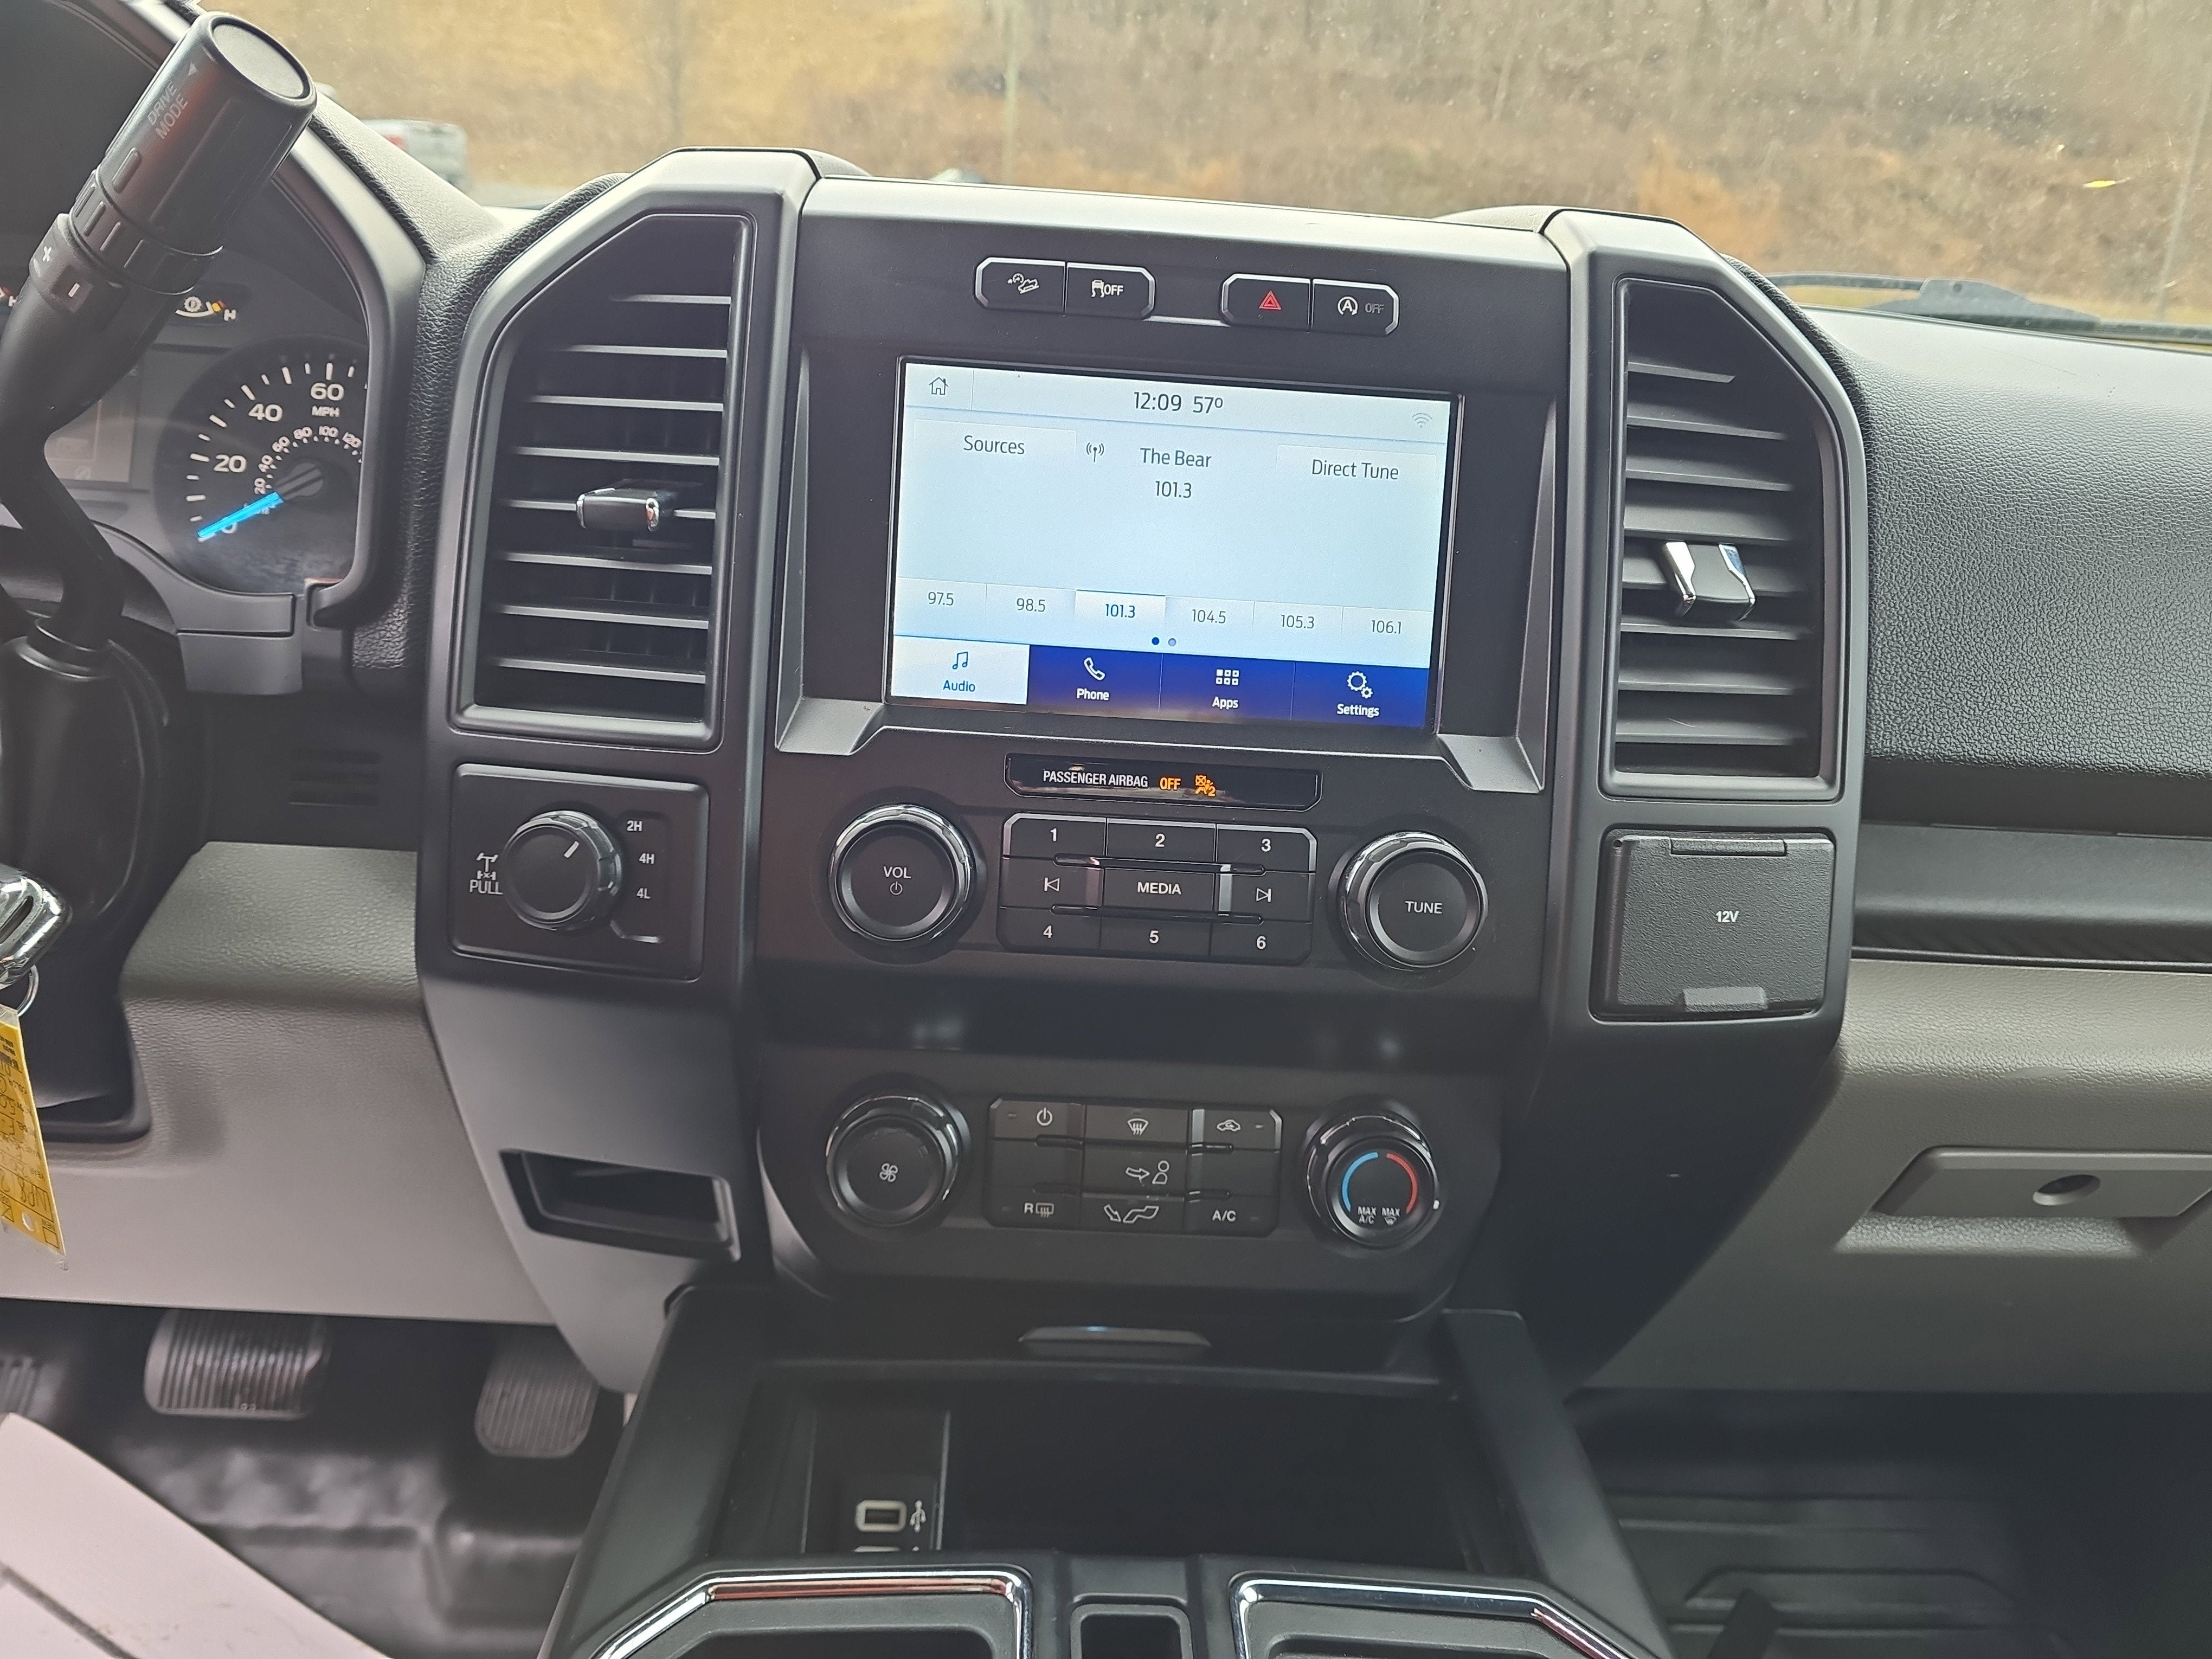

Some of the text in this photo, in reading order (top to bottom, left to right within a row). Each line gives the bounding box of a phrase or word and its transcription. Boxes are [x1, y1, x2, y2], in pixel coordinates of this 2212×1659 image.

[146, 80, 177, 126] DRIVE
[155, 93, 189, 140] MODE
[1103, 283, 1124, 297] OFF
[1365, 303, 1384, 314] OFF
[310, 382, 344, 401] 60
[1134, 391, 1182, 411] 12:09
[248, 403, 284, 423] 40
[311, 406, 340, 417] MPH
[292, 426, 313, 440] 80
[318, 425, 339, 438] 100
[272, 436, 290, 453] 60
[963, 435, 1025, 454] Sources
[214, 454, 247, 473] 20
[1140, 447, 1212, 467] The Bear
[1311, 459, 1399, 480] Direct Tune
[1155, 480, 1192, 498] 101.3
[928, 591, 954, 606] 97.5
[1017, 597, 1046, 612] 98.5
[1105, 603, 1135, 618] 101.3
[1192, 609, 1226, 624] 104.5
[1281, 614, 1314, 629] 105.3
[1372, 620, 1401, 634] 106.1
[943, 679, 975, 692] Audio
[1076, 688, 1110, 700] Phone
[1212, 696, 1239, 710] Apps
[1336, 703, 1380, 718] Settings
[1043, 769, 1182, 791] PASSENGER AIRBAG OFF
[626, 820, 642, 832] 2H
[1050, 828, 1057, 841] 1
[1155, 833, 1165, 847] 2
[1261, 838, 1271, 852] 3
[639, 853, 654, 864] 4H
[883, 866, 912, 879] VOL
[468, 878, 504, 895] PULL
[636, 888, 651, 899] 4L
[1137, 882, 1181, 895] MEDIA
[1405, 901, 1443, 914] TUNE
[1715, 910, 1740, 923] 12V
[1043, 925, 1053, 938] 4
[1149, 930, 1159, 944] 5
[1256, 936, 1266, 949] 6
[1024, 1203, 1034, 1214] R
[1356, 1205, 1377, 1217] MAX
[1381, 1207, 1401, 1218] MAX
[1212, 1210, 1236, 1222] A/C
[1358, 1215, 1375, 1224] A/C
